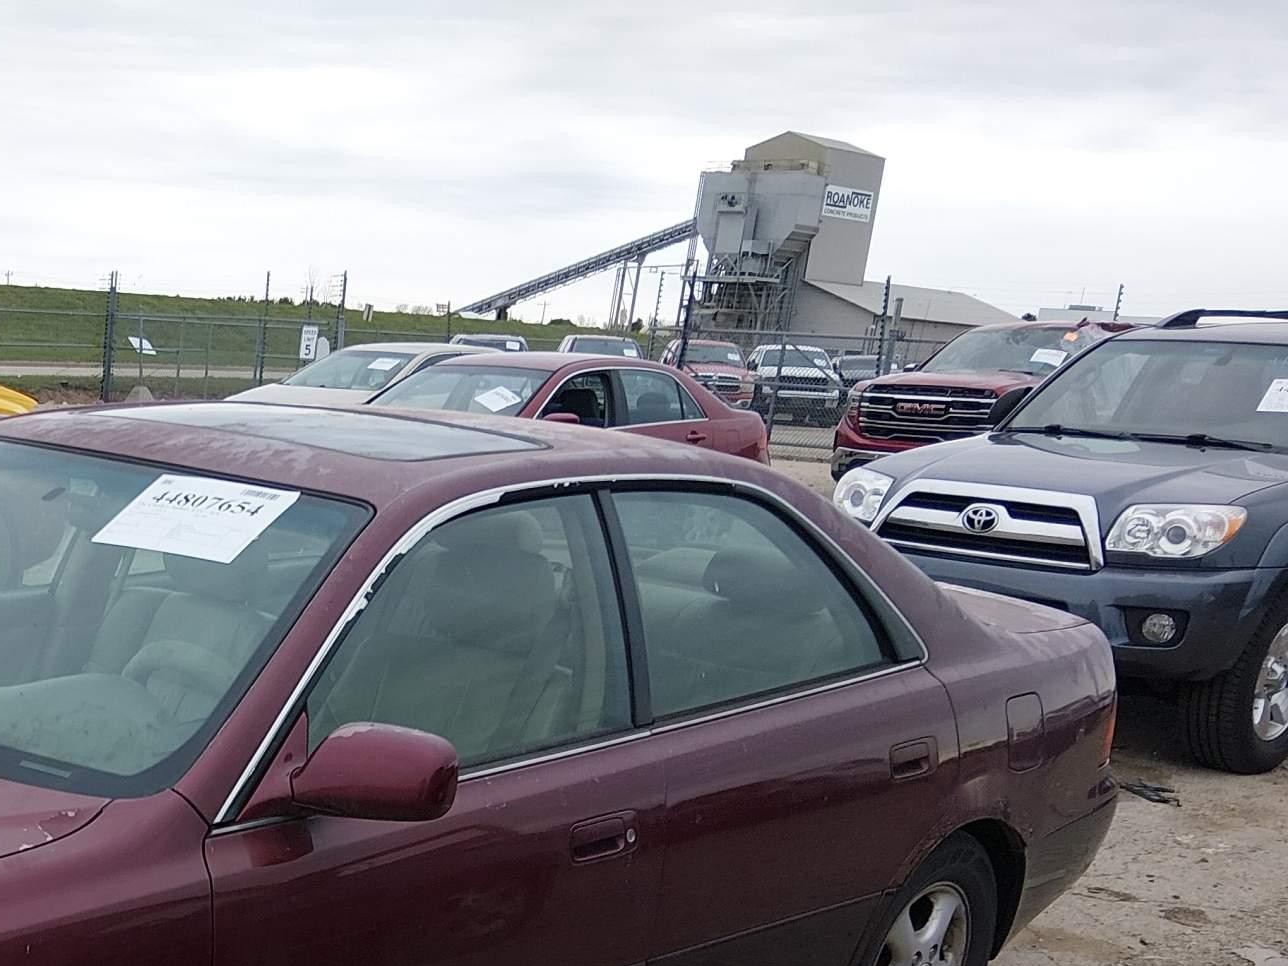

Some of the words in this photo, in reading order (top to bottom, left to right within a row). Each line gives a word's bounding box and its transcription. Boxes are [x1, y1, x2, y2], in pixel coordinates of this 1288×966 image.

[825, 191, 872, 209] ROANOKE
[304, 344, 311, 356] 5
[896, 402, 946, 415] GMC
[152, 491, 265, 517] 44807654
